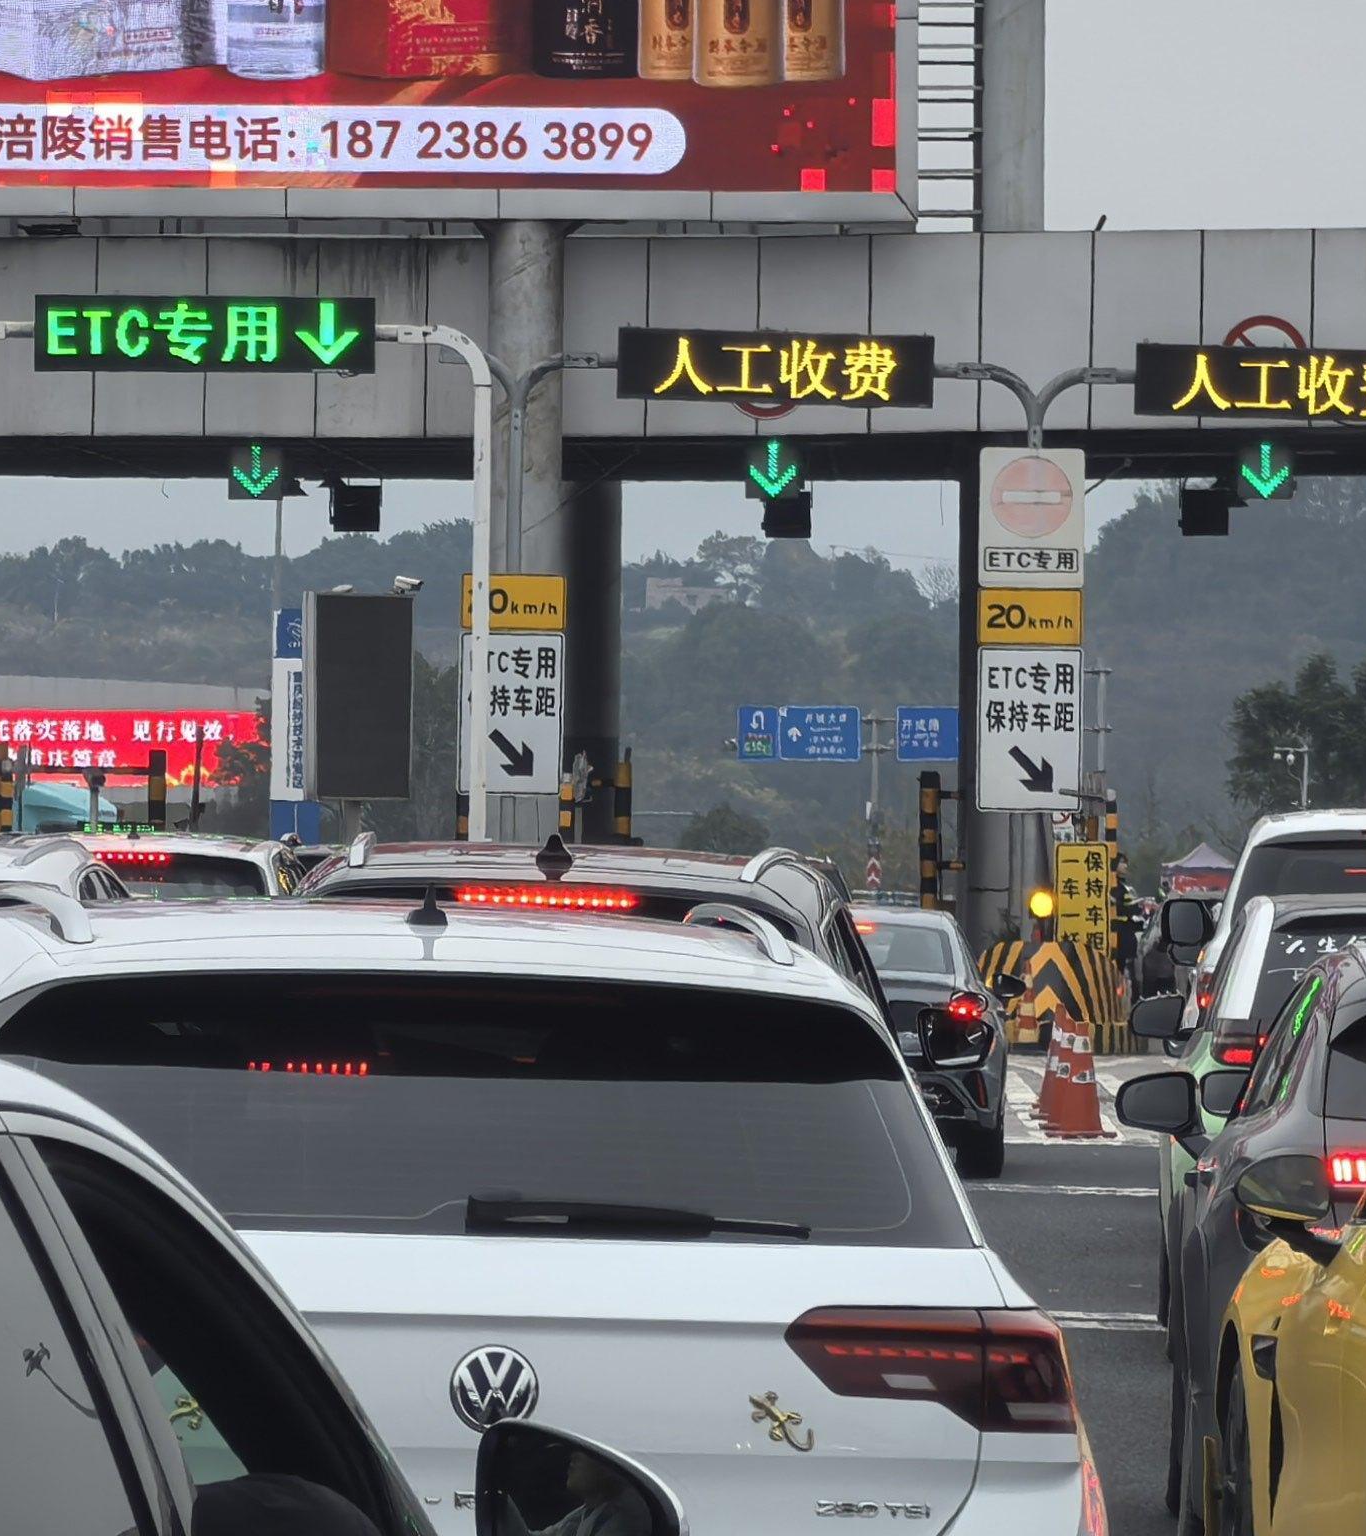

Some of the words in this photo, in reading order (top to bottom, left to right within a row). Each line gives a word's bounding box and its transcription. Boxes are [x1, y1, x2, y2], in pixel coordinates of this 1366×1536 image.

[320, 120, 402, 159] 187
[416, 120, 528, 160] 2386
[542, 121, 653, 162] 3899
[46, 304, 278, 364] ETC专用
[653, 337, 898, 402] 人工收费
[988, 550, 1074, 570] ETC专用
[468, 646, 557, 680] TC专用
[988, 662, 1075, 695] ETC专用
[467, 684, 556, 718] 持车距
[985, 699, 1075, 734] 保持车距
[1084, 850, 1105, 951] 保持车距
